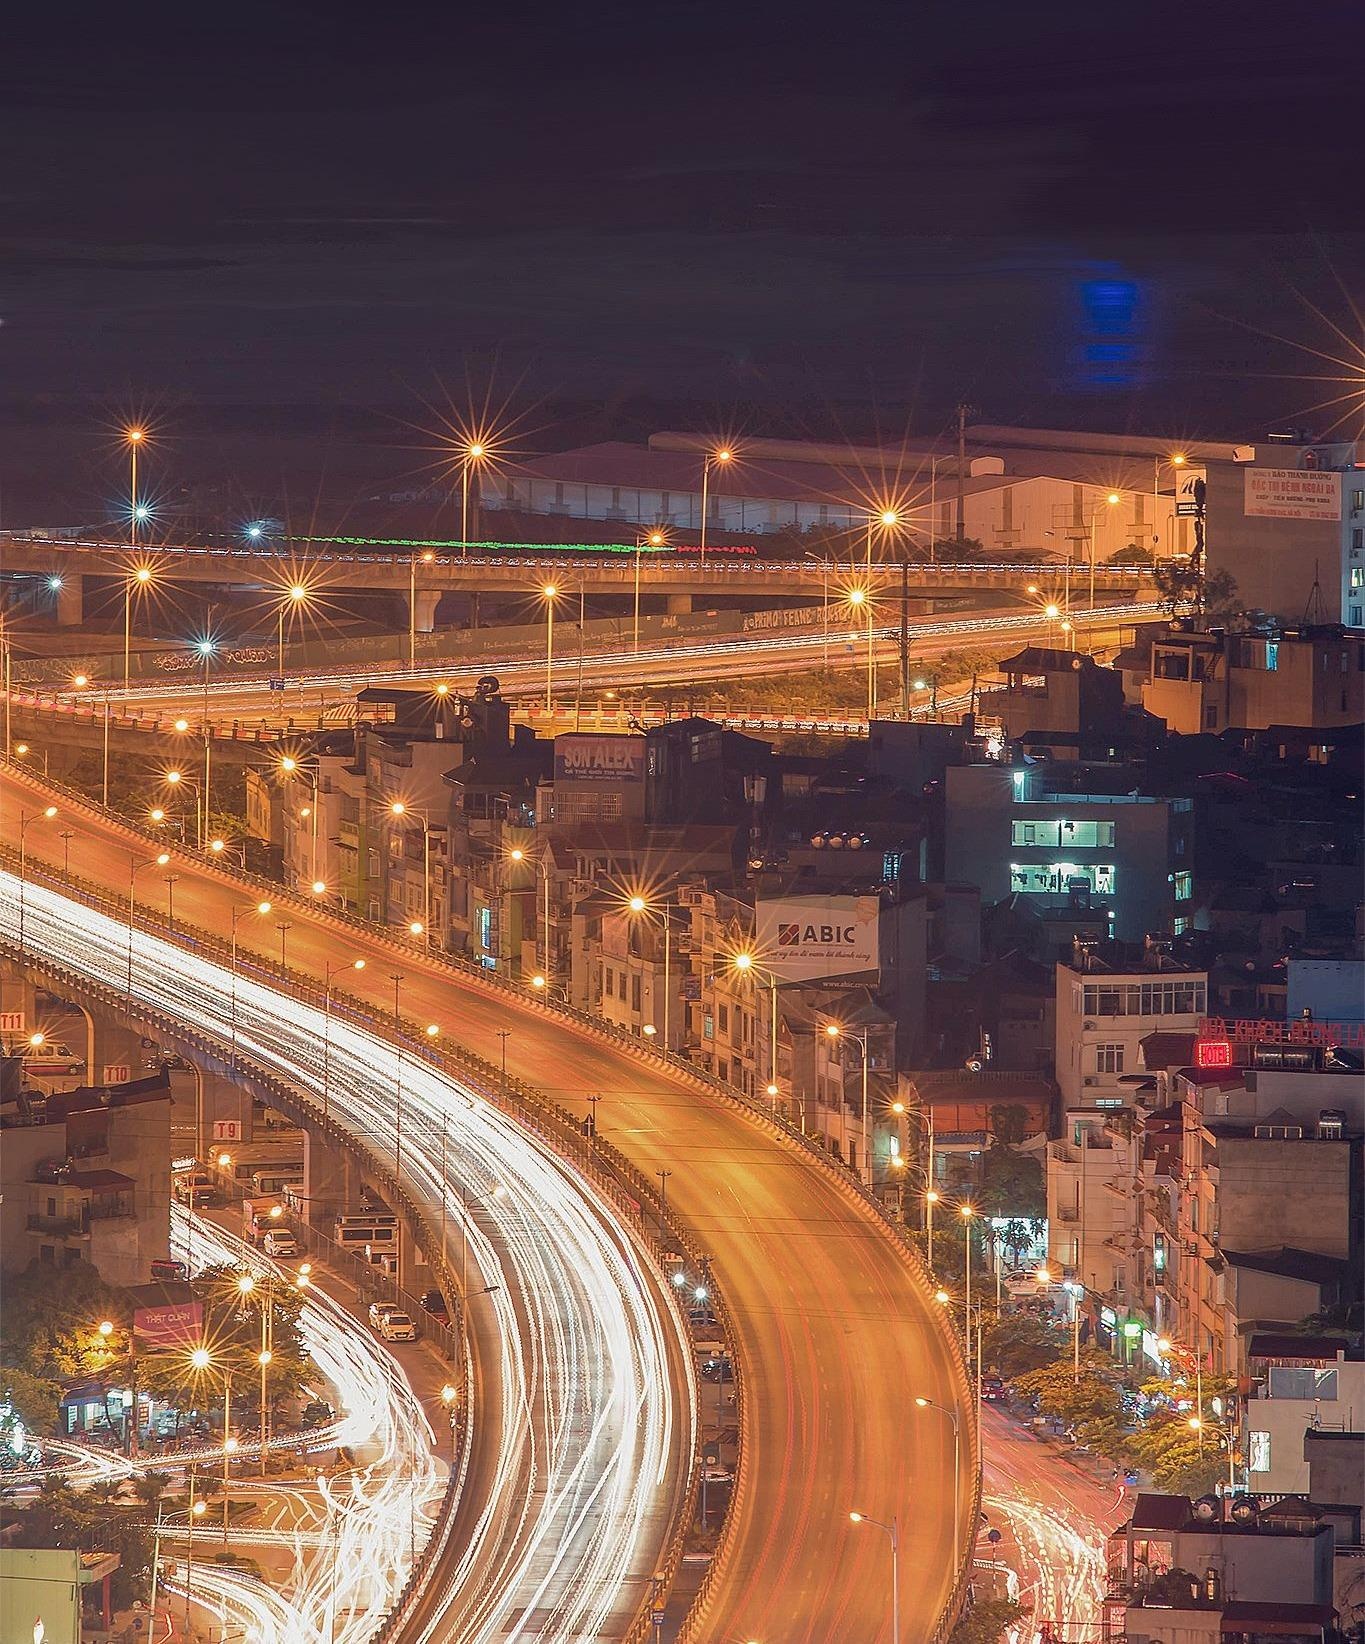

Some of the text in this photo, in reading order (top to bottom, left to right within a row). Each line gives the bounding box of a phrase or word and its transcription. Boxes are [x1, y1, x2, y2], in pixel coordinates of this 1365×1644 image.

[593, 745, 634, 769] ALEX
[802, 925, 855, 943] ABIC
[1, 1015, 22, 1029] T11
[106, 1067, 128, 1082] T10
